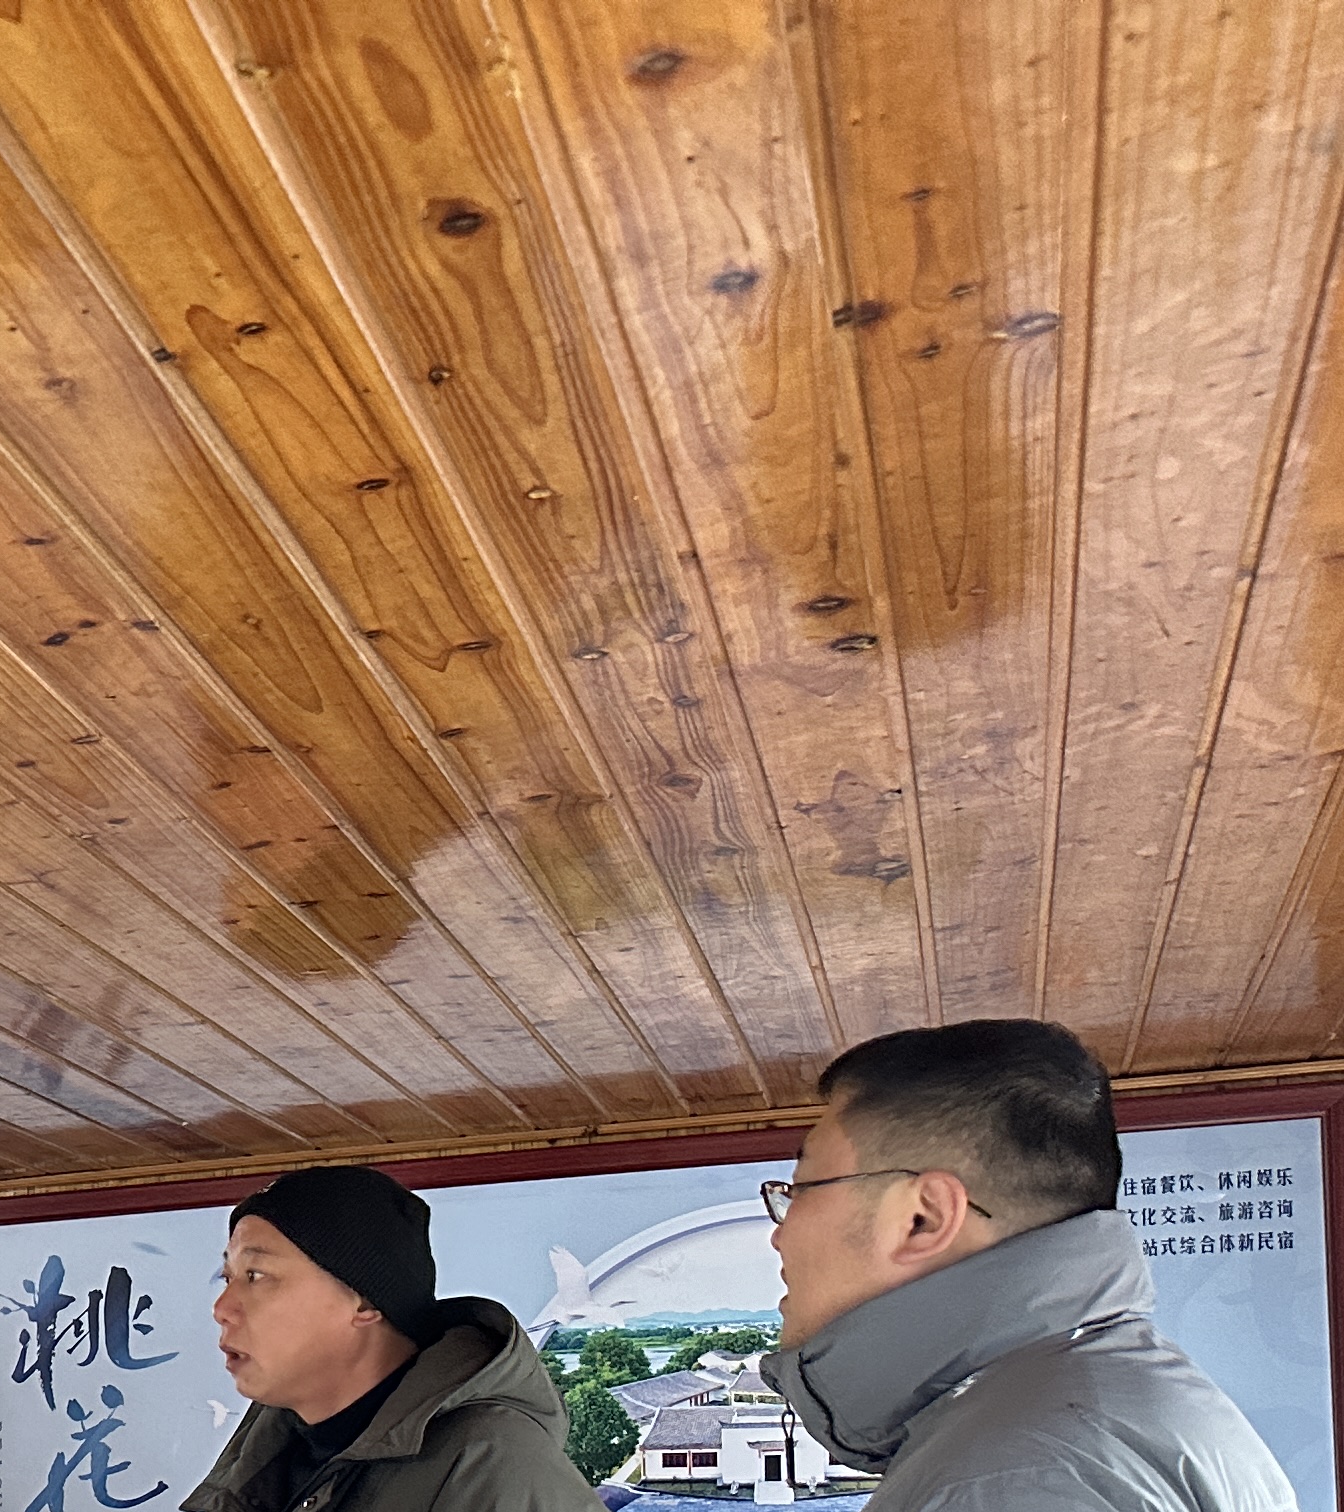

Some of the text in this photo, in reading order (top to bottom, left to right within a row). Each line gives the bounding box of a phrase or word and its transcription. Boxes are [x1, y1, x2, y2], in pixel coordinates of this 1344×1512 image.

[1123, 1167, 1294, 1196] 住宿餐饮、休闲娱乐
